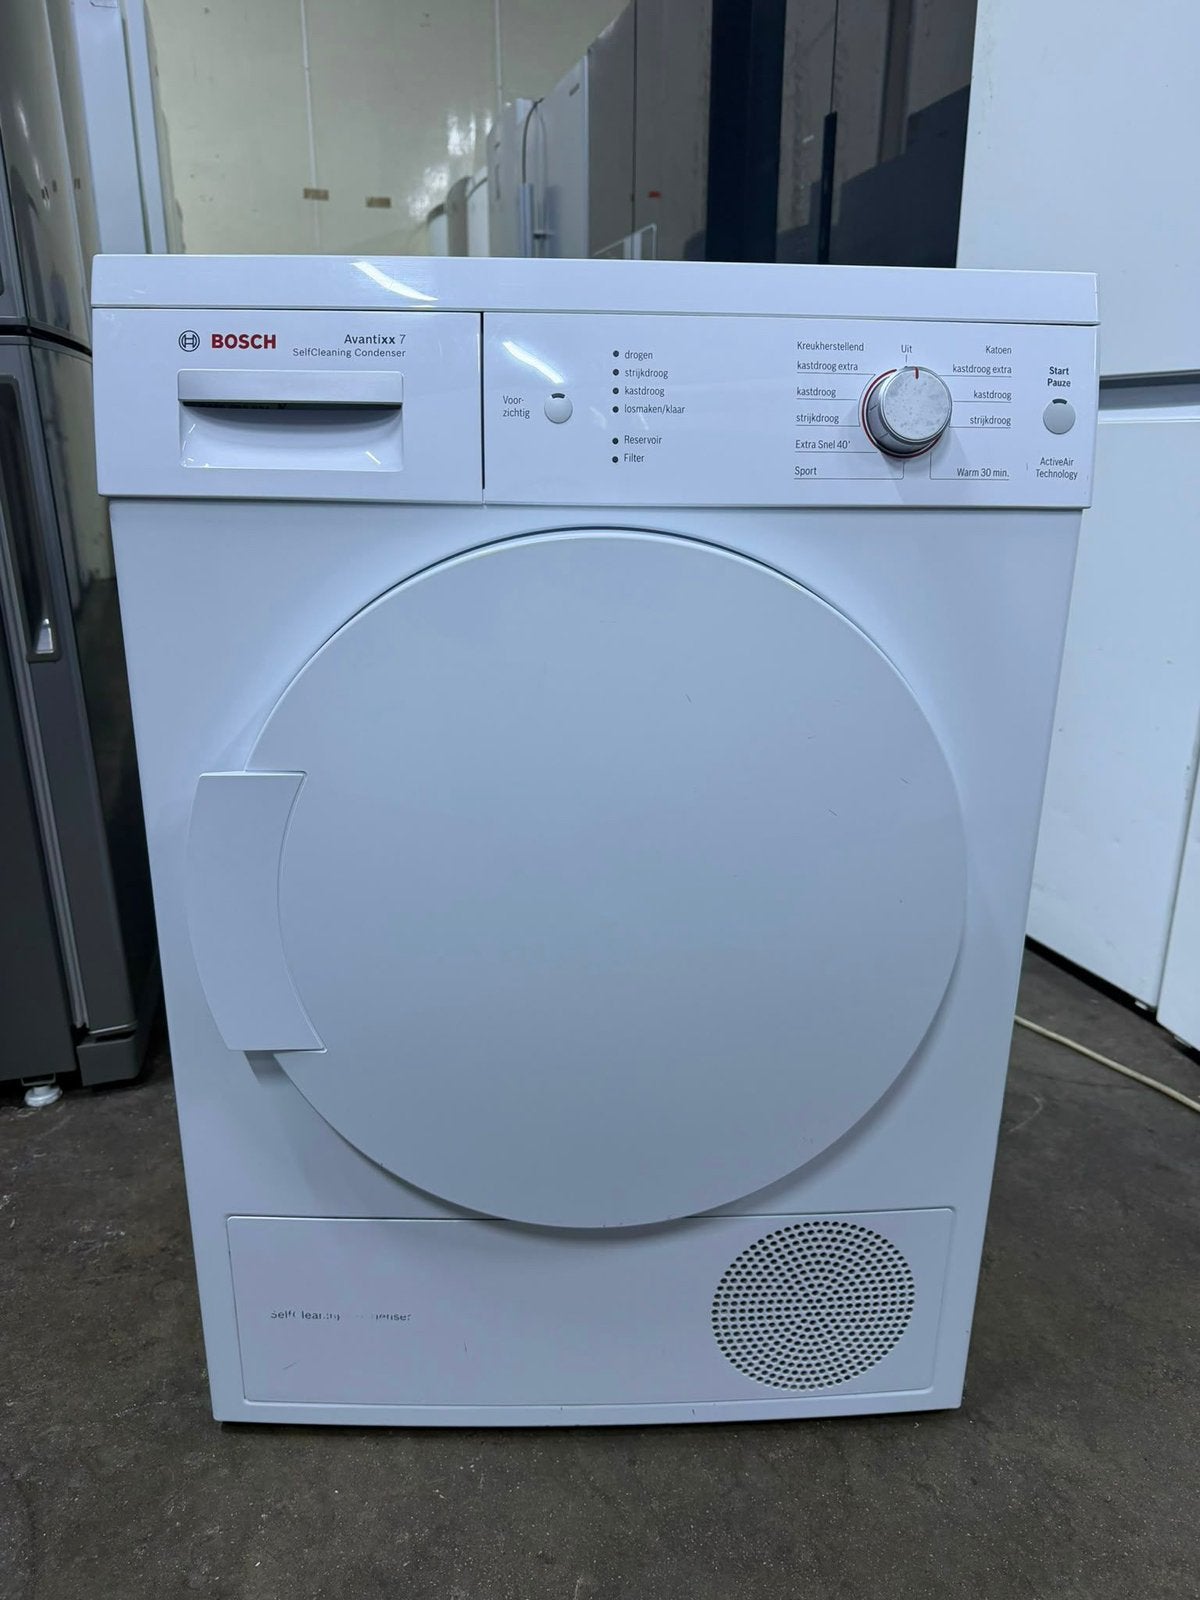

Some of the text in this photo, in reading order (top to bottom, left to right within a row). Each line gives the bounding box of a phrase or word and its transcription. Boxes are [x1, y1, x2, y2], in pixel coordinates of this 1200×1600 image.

[211, 333, 277, 350] BOSCH
[343, 333, 407, 345] Avantixx 7
[796, 341, 865, 352] Kreukherstellend
[900, 344, 913, 354] Uit
[985, 345, 1012, 355] Katoen
[292, 347, 407, 359] SelfCleaning Condenser
[624, 349, 654, 361] drogen
[796, 360, 859, 372] kastdroog extra
[952, 363, 1012, 375] kastdroog extra
[1049, 366, 1070, 376] Start
[624, 367, 669, 380] strijkdroog
[1047, 377, 1072, 388] Pauze
[624, 385, 665, 398] kastdroog
[796, 386, 837, 398] kastdroog
[973, 389, 1012, 401] kastdroog
[502, 395, 525, 405] Voor-
[502, 407, 531, 420] zichtig
[624, 403, 686, 415] losmaken/klaar
[796, 413, 840, 425] strijkdroog
[969, 415, 1012, 427] strijkdroog
[624, 434, 663, 445] Reservoir
[795, 439, 817, 449] Extra
[817, 439, 836, 450] Snel
[623, 452, 645, 463] Filter
[1039, 456, 1075, 467] ActiveAir
[794, 465, 817, 477] Sport
[956, 467, 1010, 478] Warm 30 min.
[1035, 468, 1078, 481] Technology
